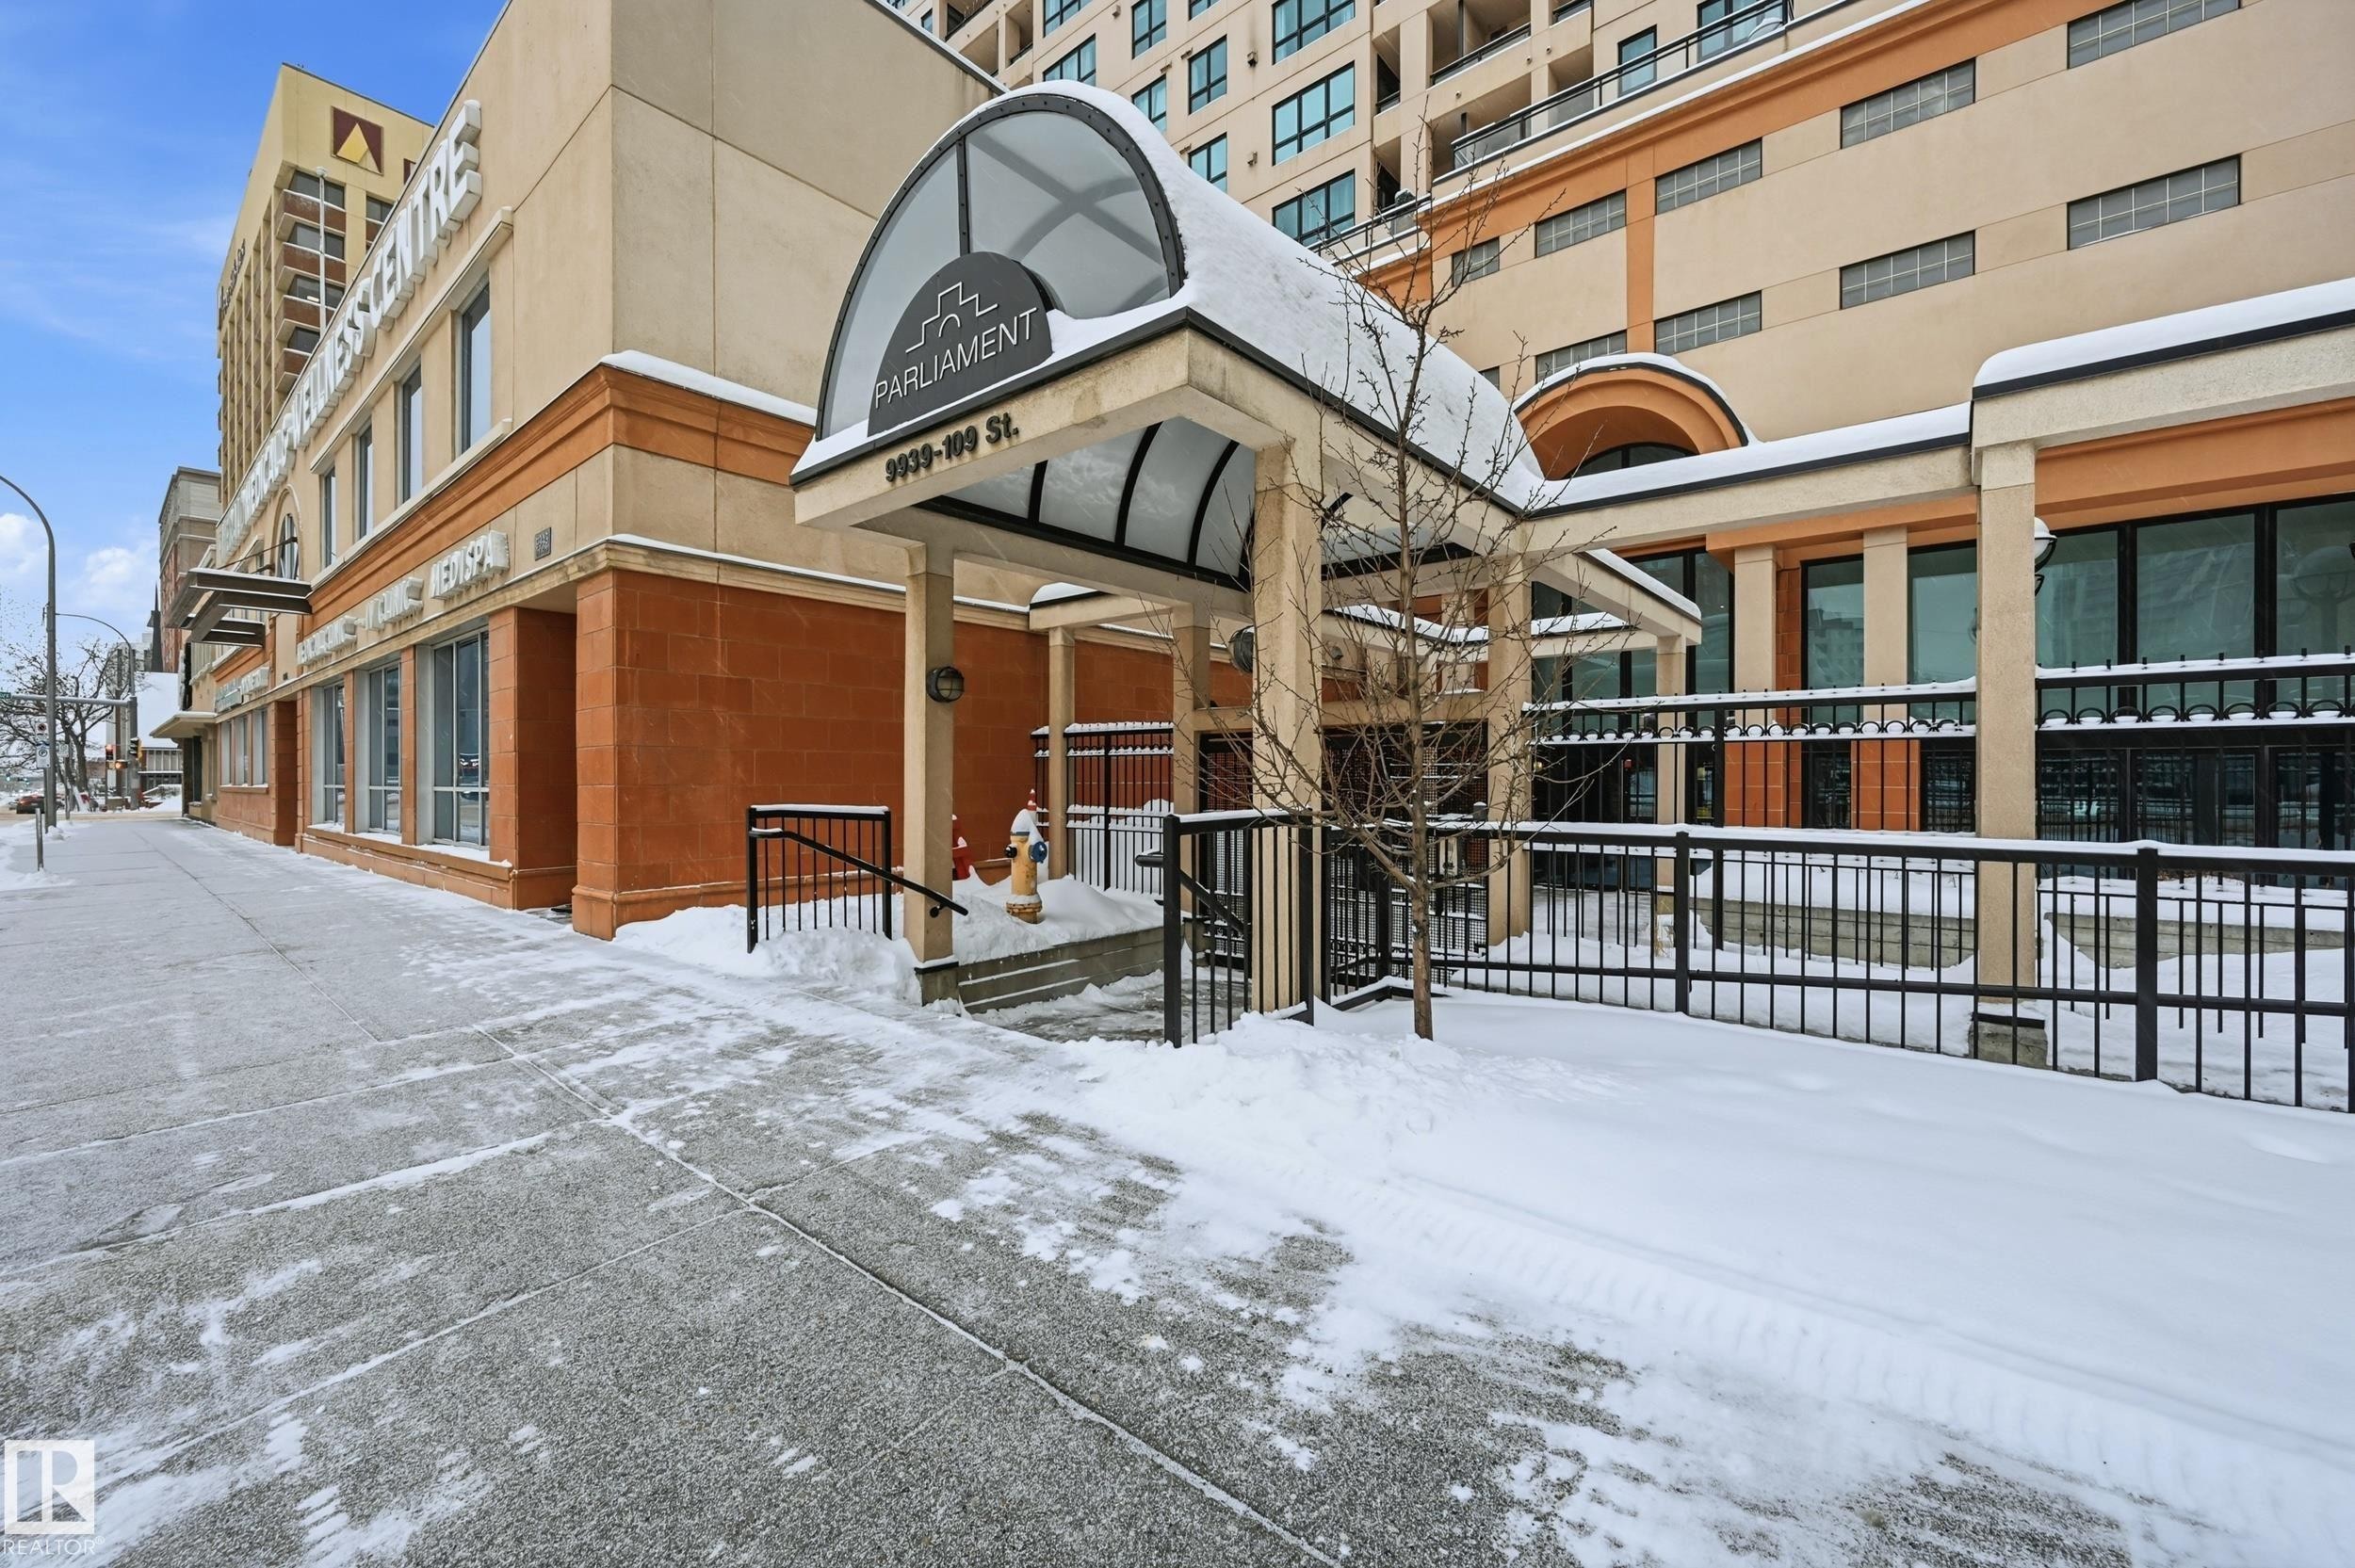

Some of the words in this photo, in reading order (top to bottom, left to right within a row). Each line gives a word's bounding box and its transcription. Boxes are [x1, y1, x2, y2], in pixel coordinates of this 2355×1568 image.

[291, 279, 377, 450] WELLNESS
[369, 100, 481, 331] CENTRE
[875, 307, 1038, 410] PARLIAMENT
[885, 426, 979, 481] 9939-109
[985, 412, 1019, 445] St.
[378, 577, 424, 623] CLINIC
[430, 530, 511, 599] MEDISPA
